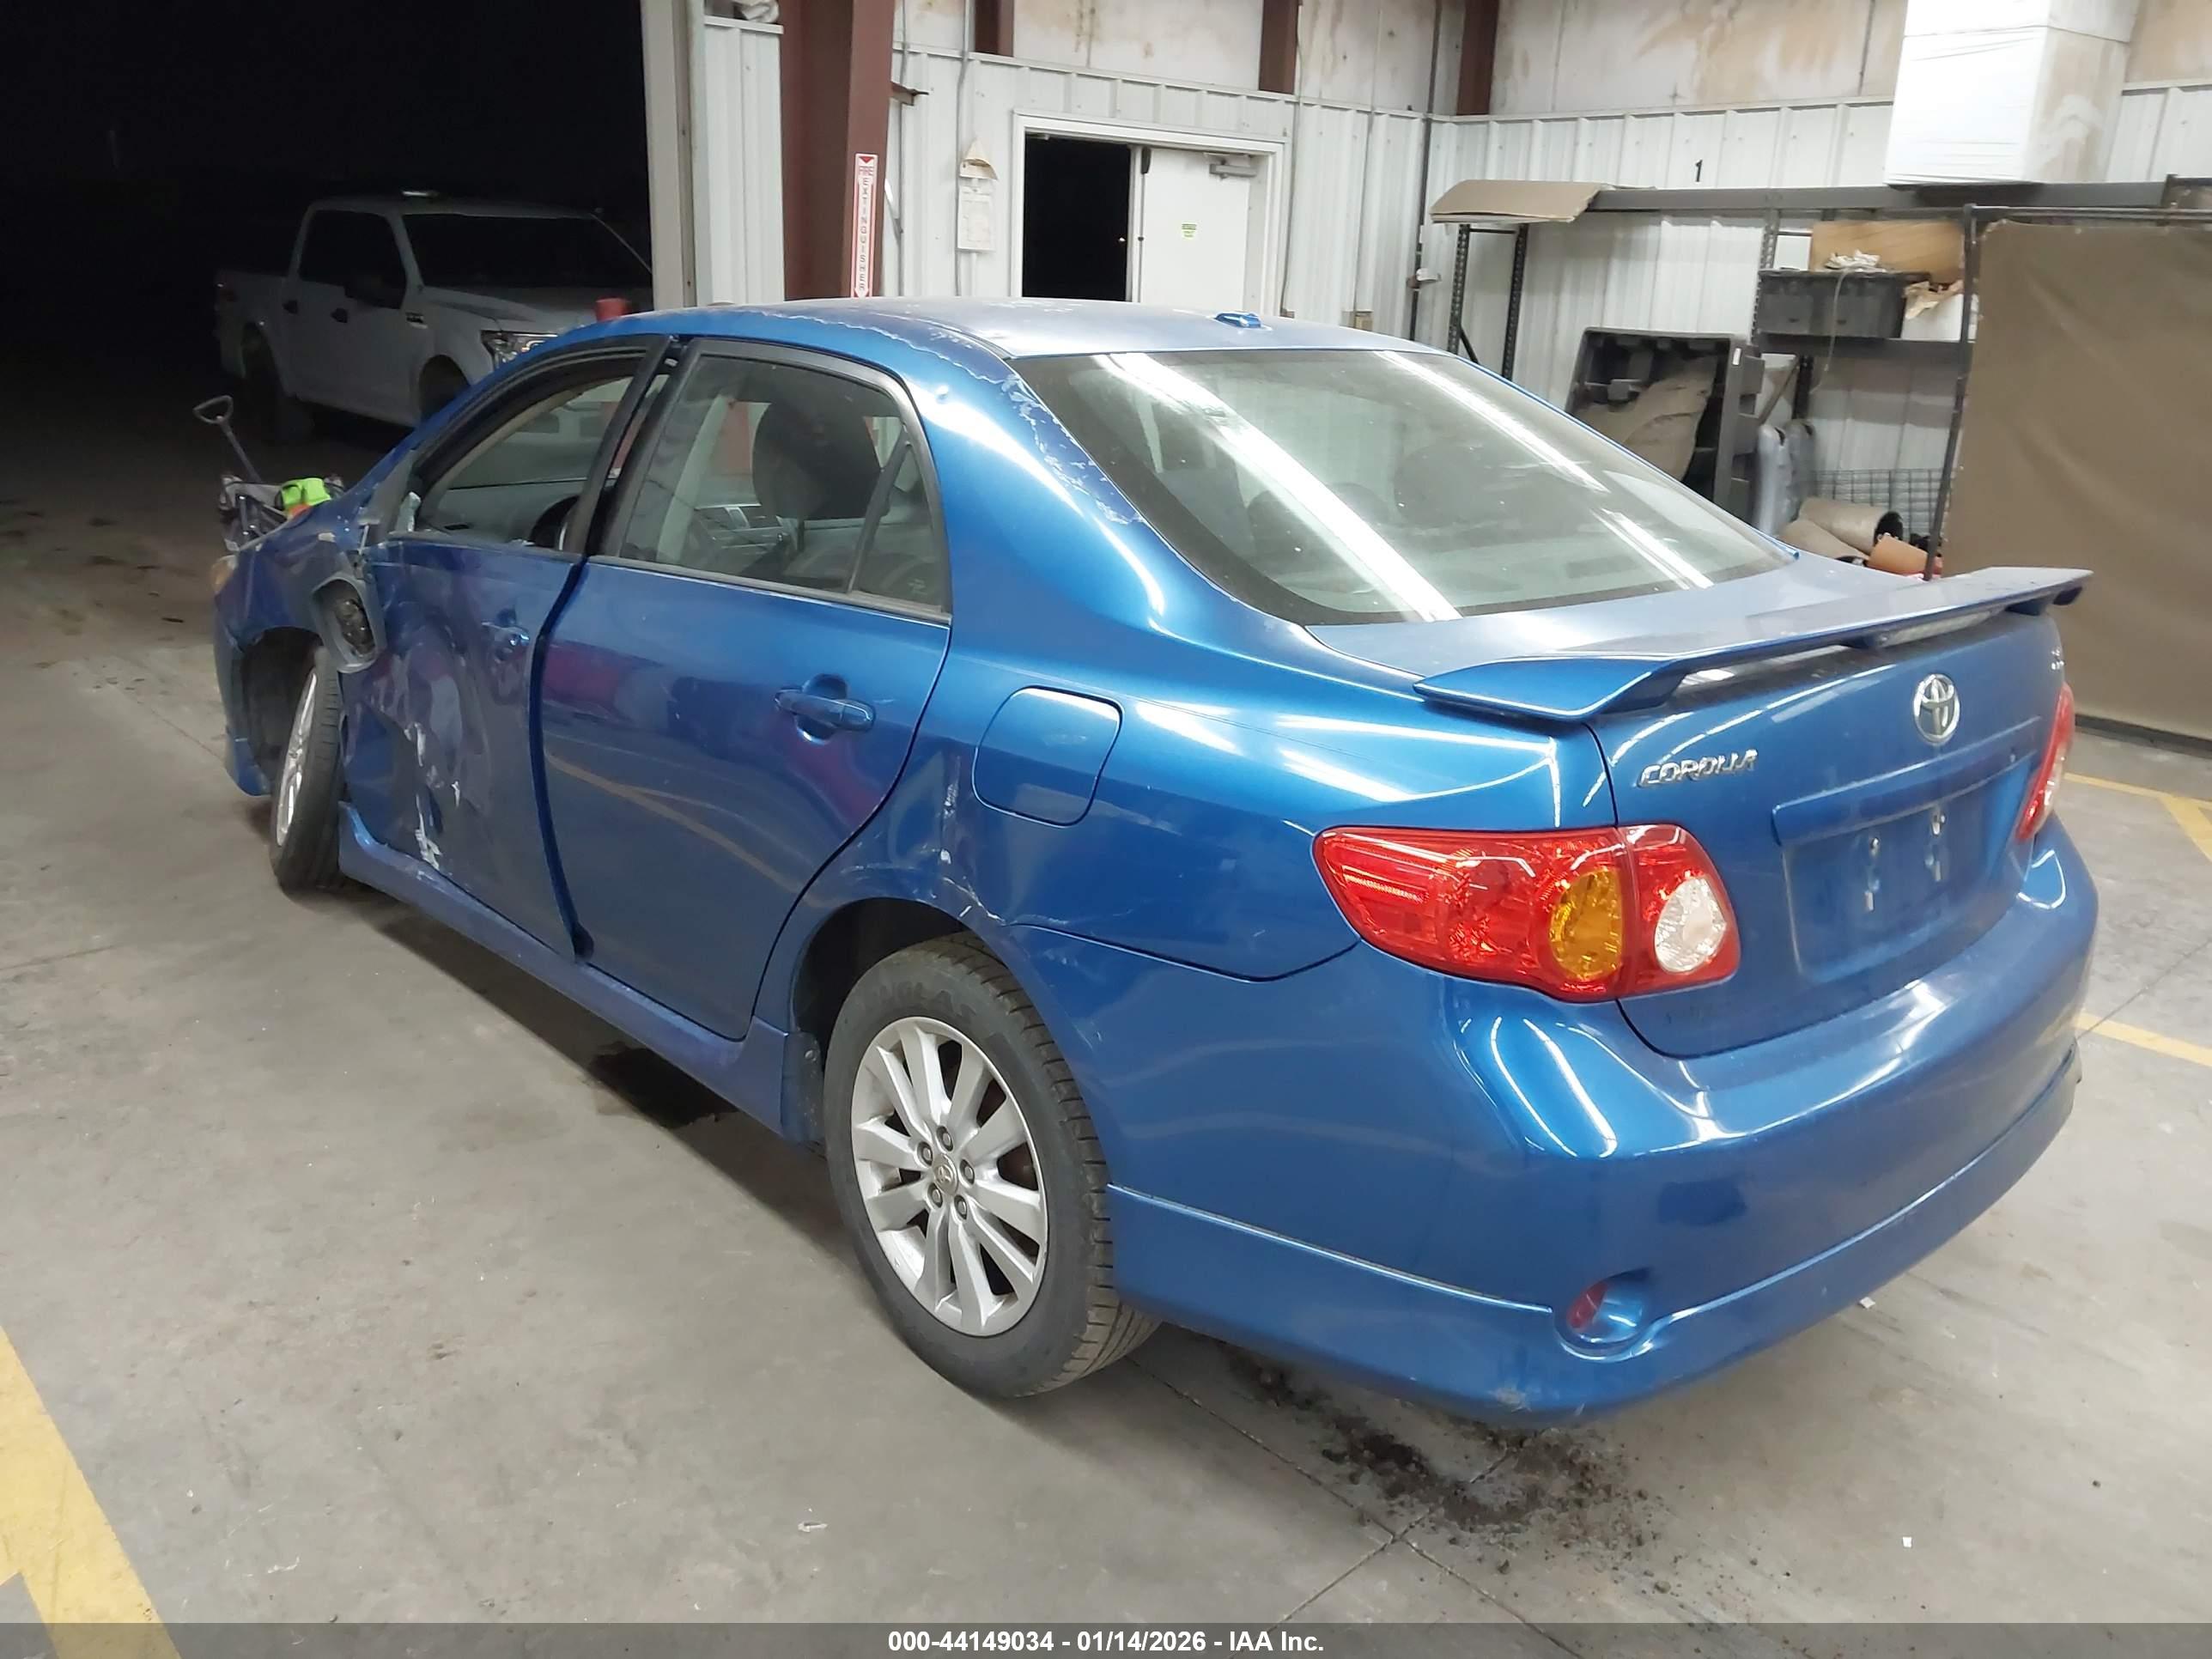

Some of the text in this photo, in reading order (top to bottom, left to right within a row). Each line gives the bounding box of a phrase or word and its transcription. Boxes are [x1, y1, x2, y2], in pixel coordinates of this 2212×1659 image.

[859, 165, 874, 176] FIRE
[1695, 159, 1703, 183] 1
[859, 177, 870, 291] EXTINGUISHER
[1637, 749, 1758, 787] COROLLA
